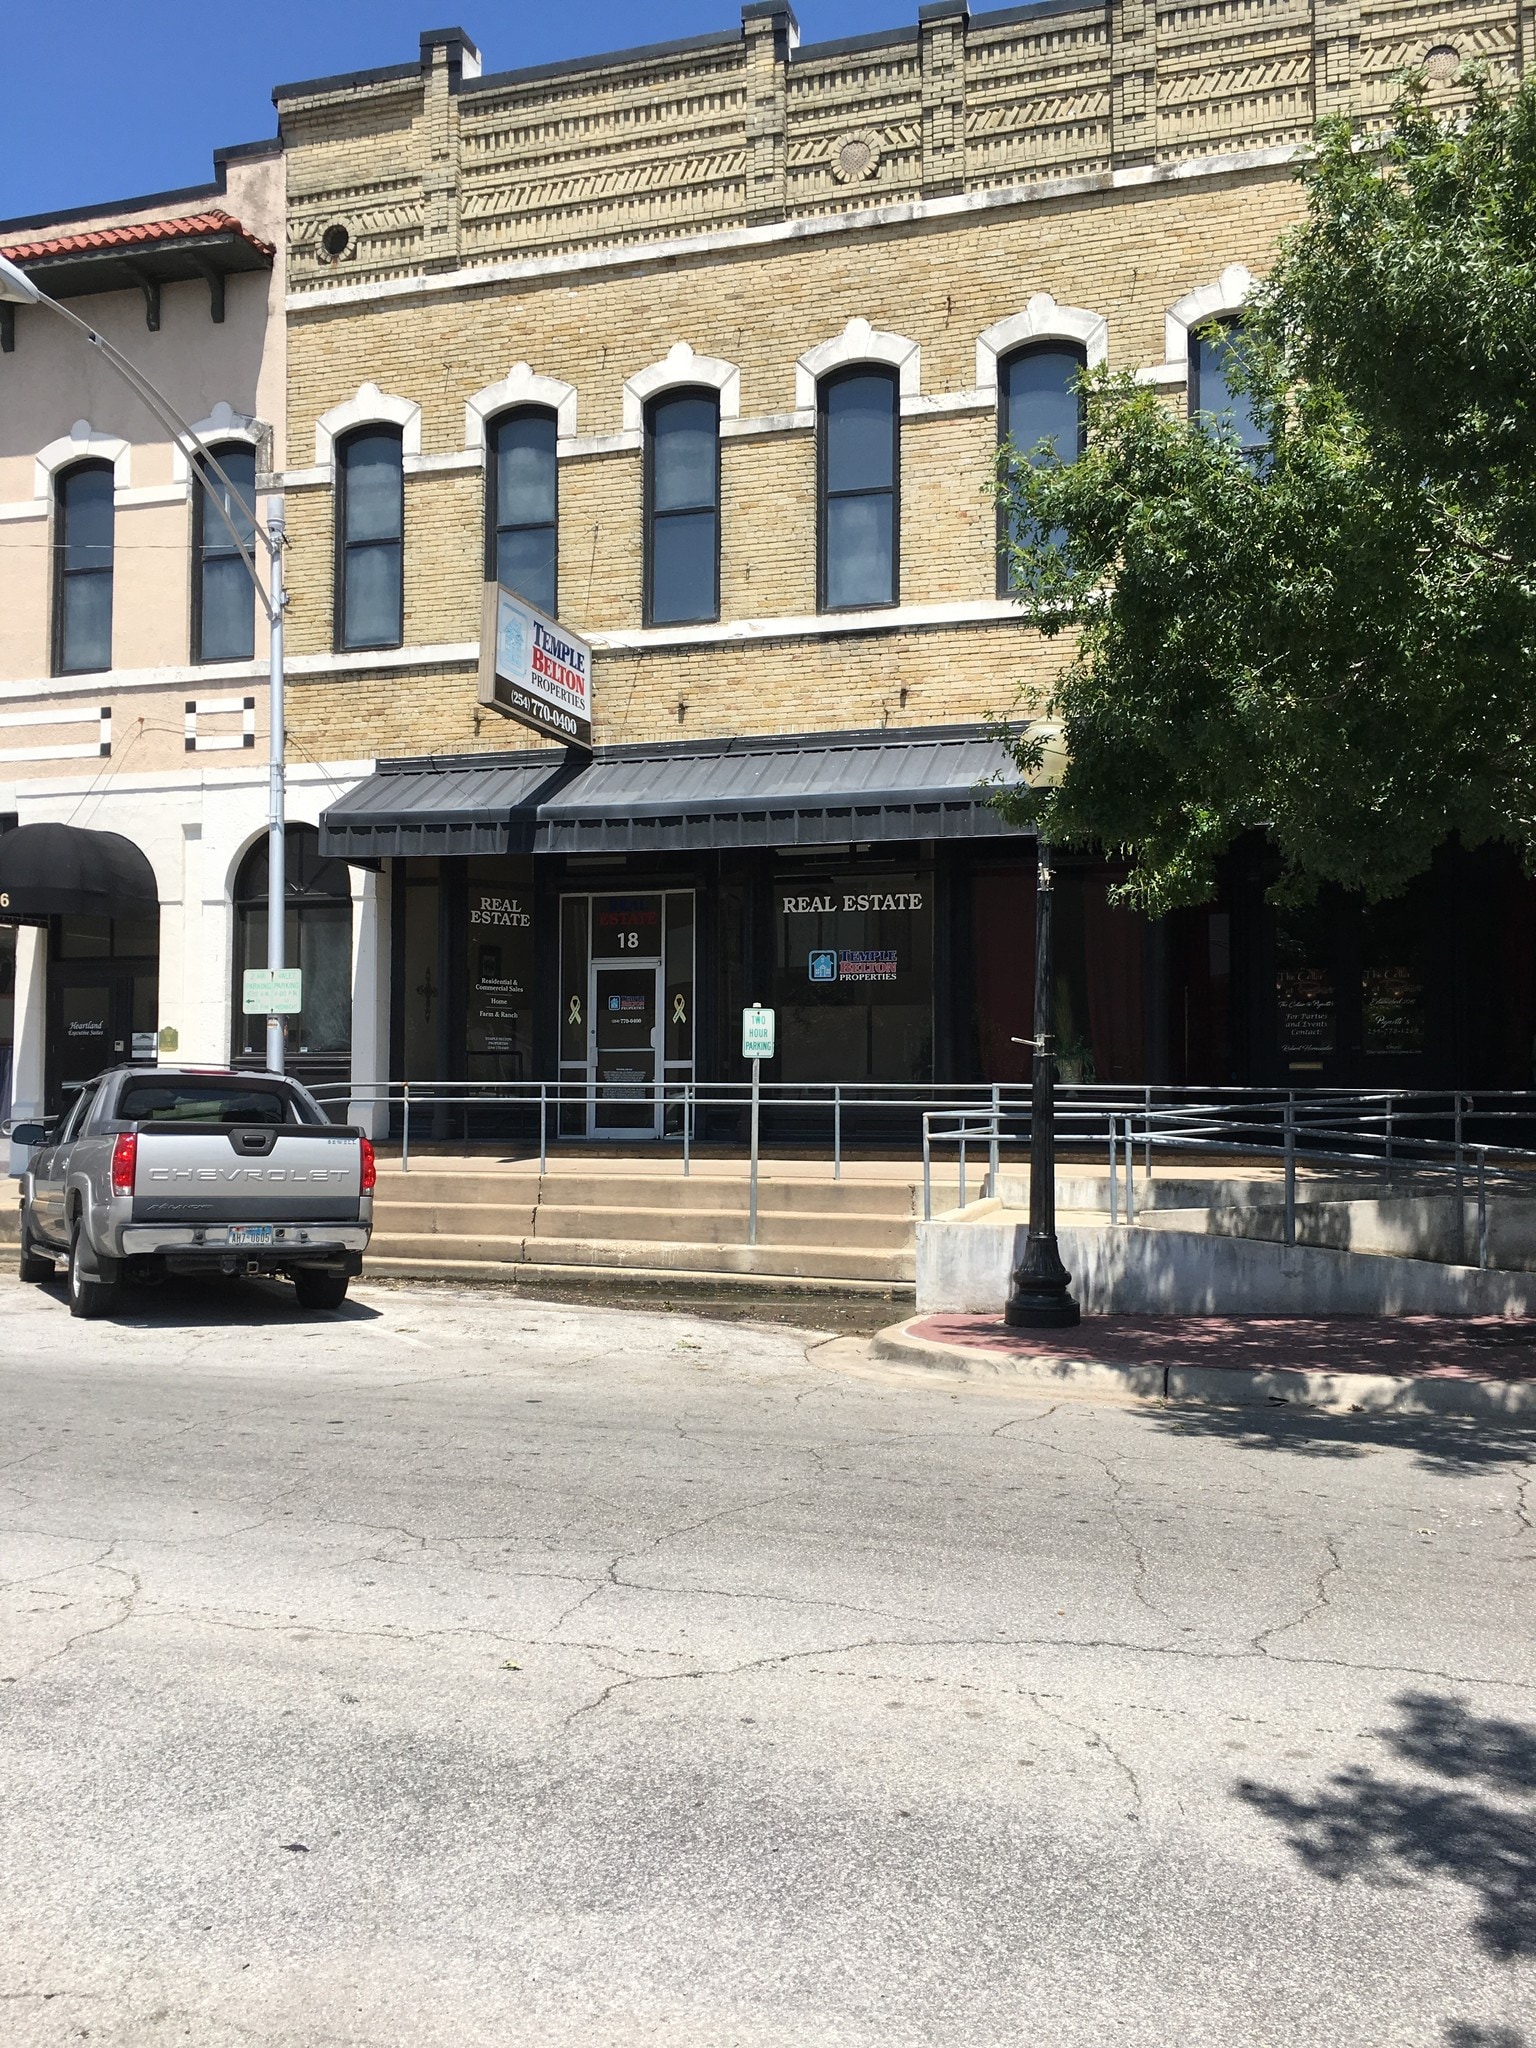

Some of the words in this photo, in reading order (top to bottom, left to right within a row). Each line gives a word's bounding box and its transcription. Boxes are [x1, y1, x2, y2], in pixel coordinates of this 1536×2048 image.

[533, 620, 585, 674] TEMPLE
[531, 646, 585, 696] BELTON
[531, 672, 586, 711] PROPERTIES
[510, 689, 531, 712] (254)
[531, 698, 578, 735] 770-0400
[480, 897, 522, 912] REAL
[782, 896, 838, 913] REAL
[842, 894, 922, 911] ESTATE
[470, 910, 530, 927] ESTATE
[600, 912, 657, 926] ESTATE
[618, 932, 638, 948] 18
[840, 950, 898, 962] TEMPLE
[840, 962, 897, 973] BELTON
[69, 1020, 103, 1029] Heartland
[752, 1016, 766, 1024] TWO
[750, 1029, 768, 1037] HOUR
[746, 1042, 772, 1050] PARKING
[148, 1168, 350, 1182] CHEVROLET
